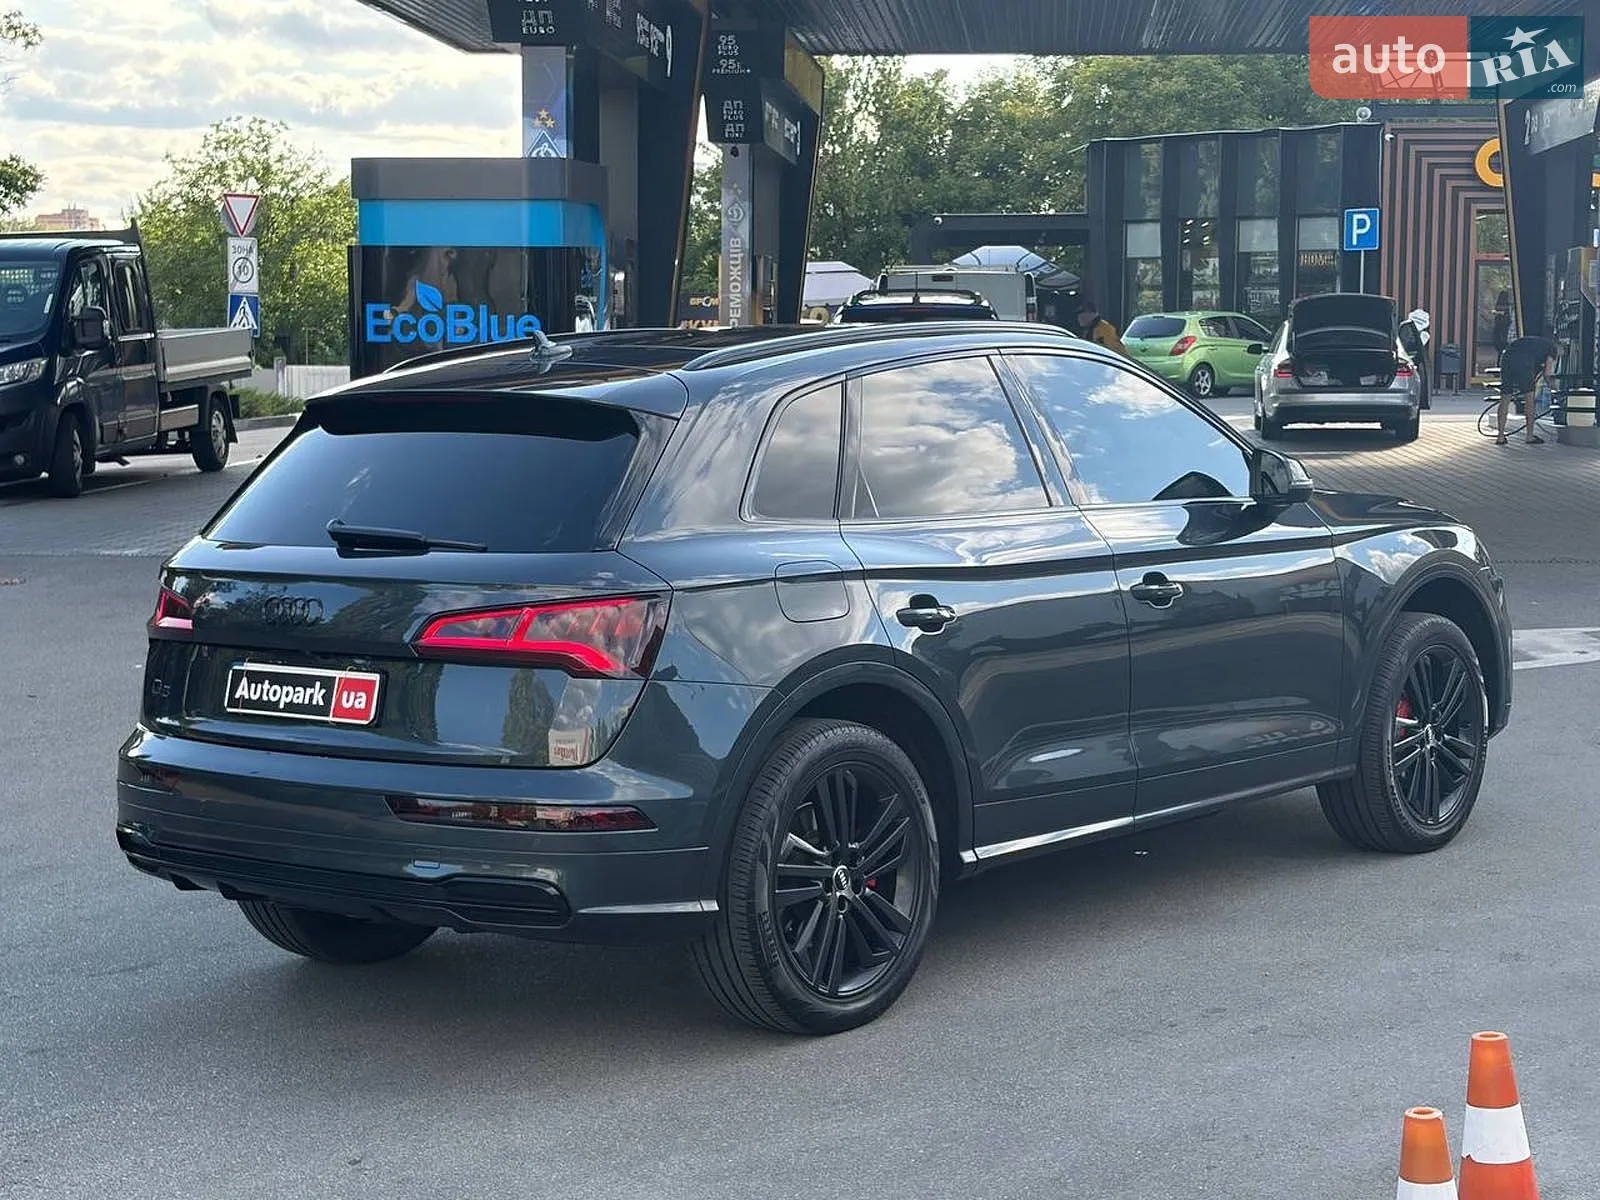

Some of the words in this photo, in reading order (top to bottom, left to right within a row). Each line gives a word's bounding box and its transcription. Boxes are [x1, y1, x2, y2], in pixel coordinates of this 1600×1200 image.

[522, 26, 555, 34] EURO
[719, 35, 736, 45] 95
[1352, 213, 1371, 246] P
[365, 303, 542, 343] EcoBlue
[234, 676, 326, 709] Autopark
[341, 689, 367, 710] ua
